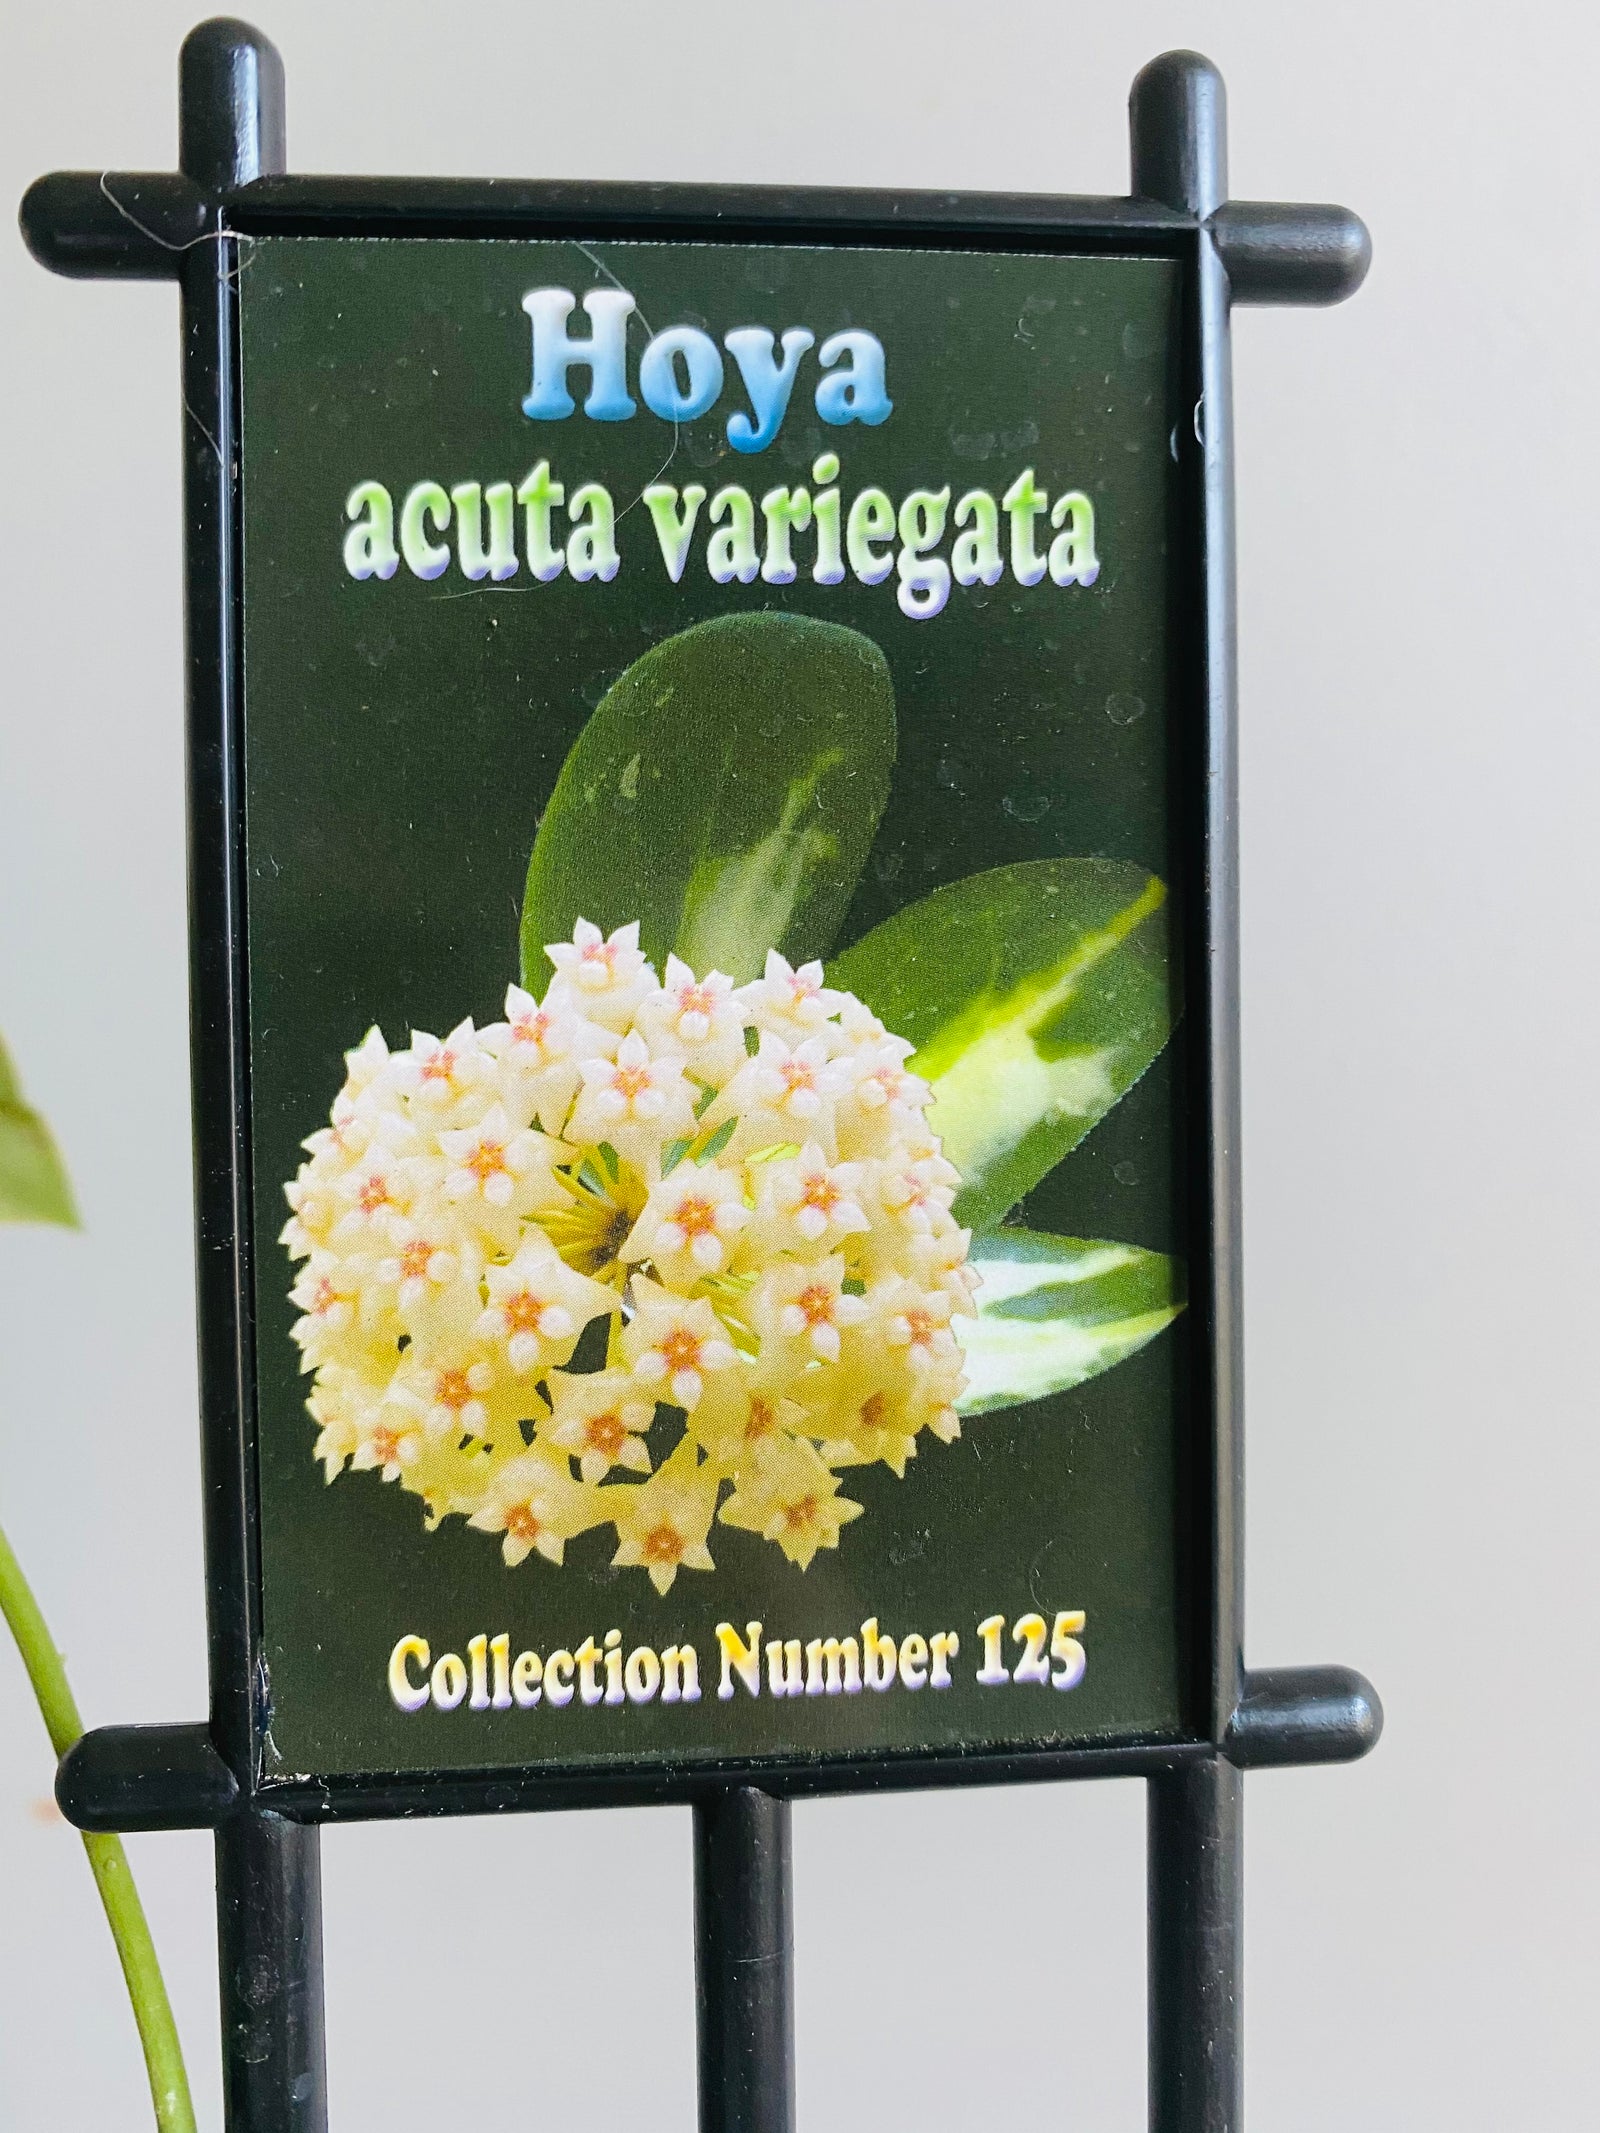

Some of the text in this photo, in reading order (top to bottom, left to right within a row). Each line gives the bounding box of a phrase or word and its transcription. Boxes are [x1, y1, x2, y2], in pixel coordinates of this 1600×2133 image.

[521, 286, 893, 453] Hoya
[343, 451, 1100, 620] acuta variegata
[388, 1609, 1087, 1712] Collection Number 125
